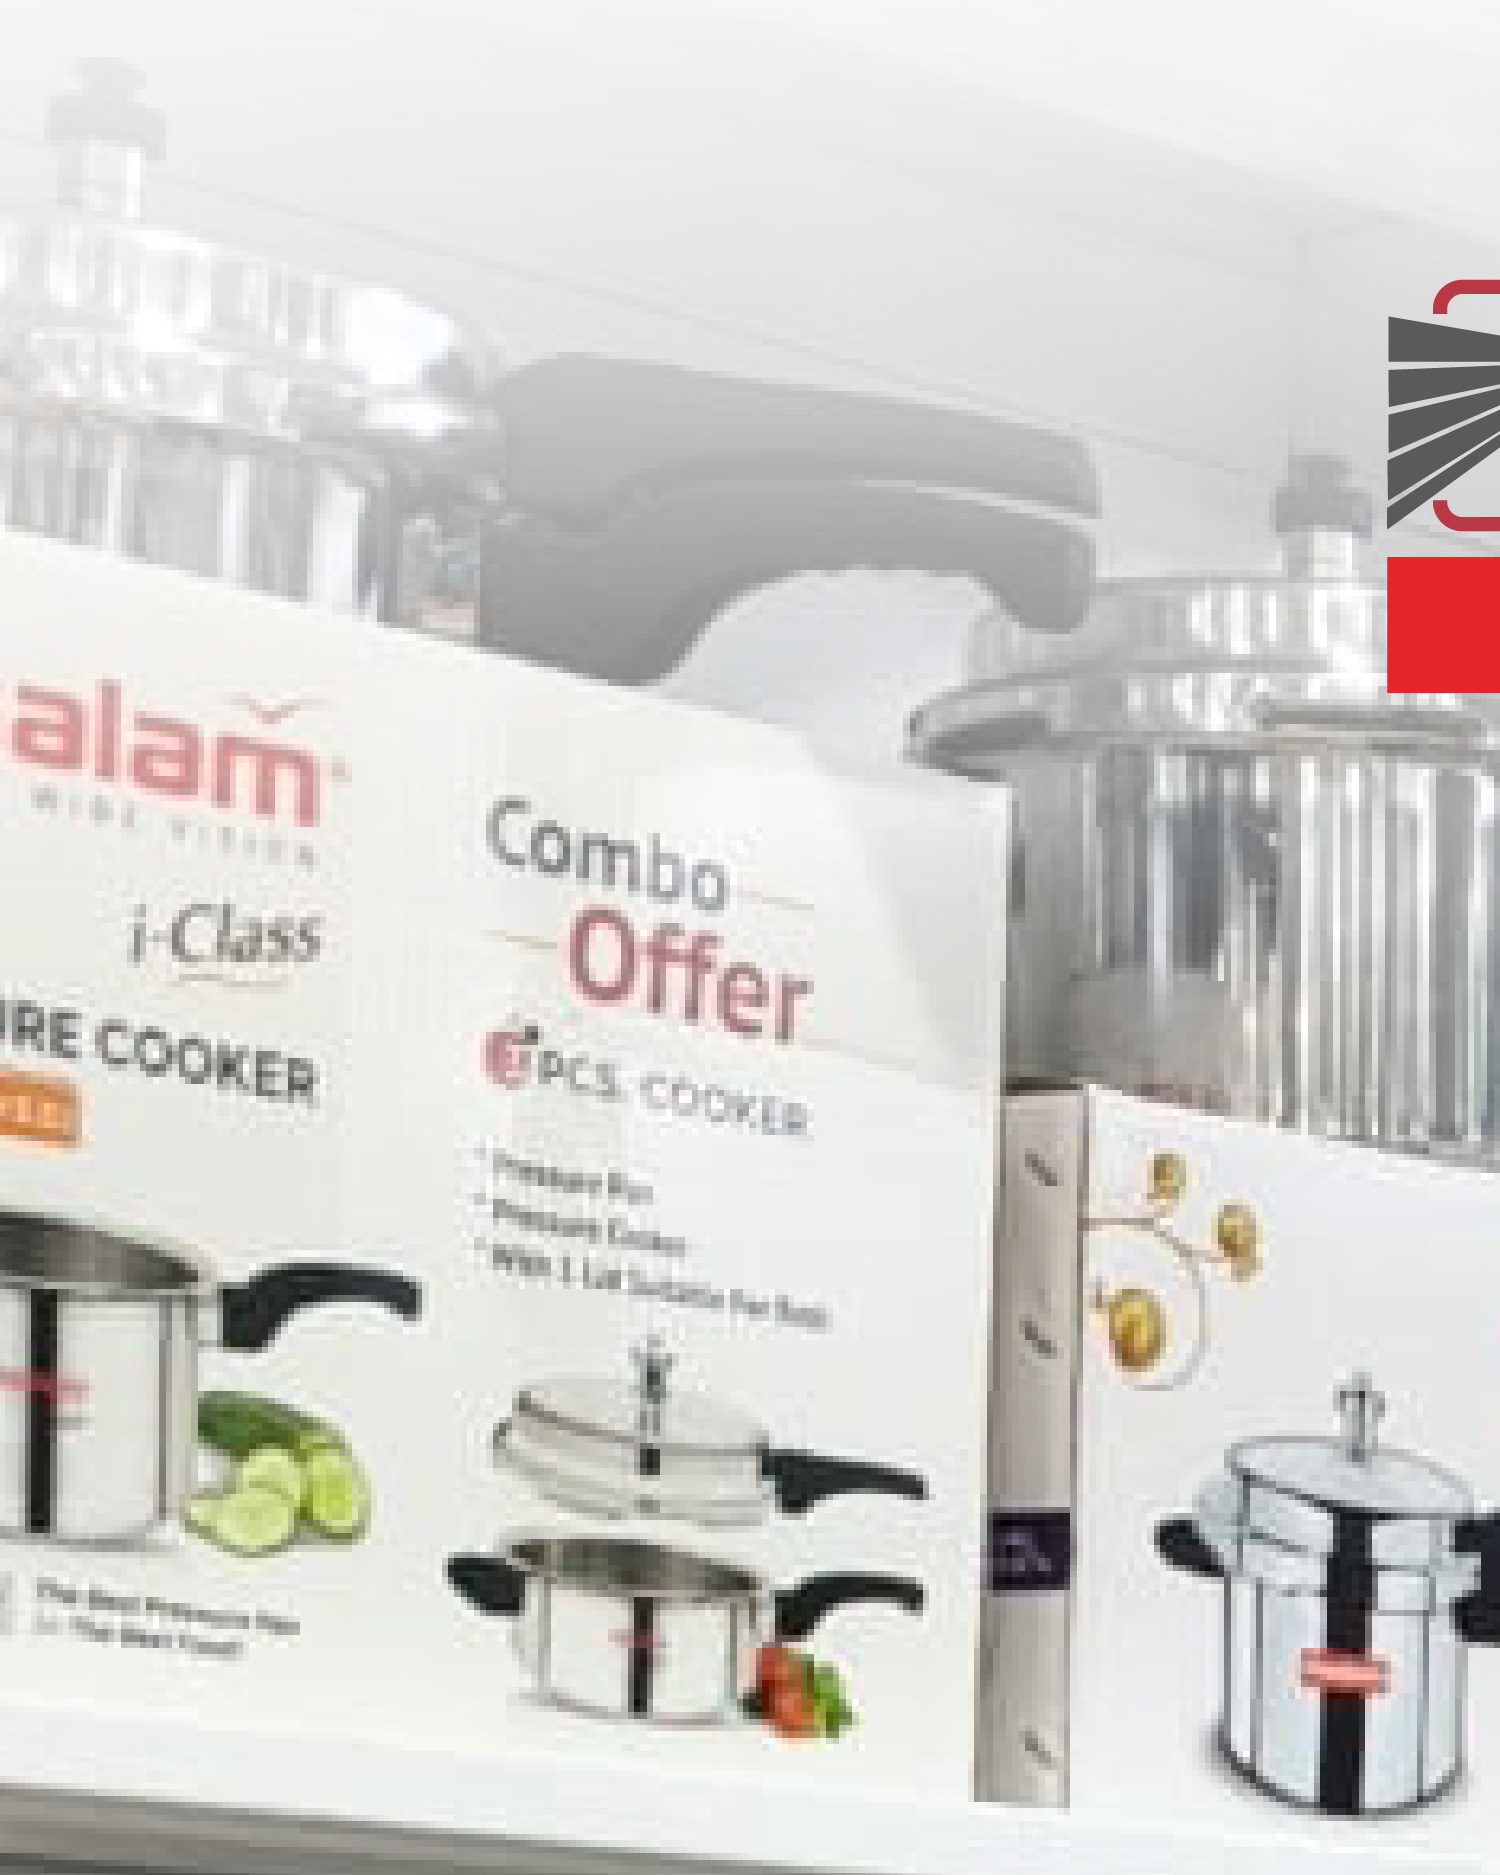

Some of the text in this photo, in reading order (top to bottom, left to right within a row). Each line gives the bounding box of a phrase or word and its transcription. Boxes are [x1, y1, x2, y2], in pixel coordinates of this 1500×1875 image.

[10, 678, 320, 828] alam
[486, 796, 730, 915] Combo
[568, 906, 814, 1045] Offer
[95, 1018, 320, 1108] COOKER
[640, 1075, 808, 1140] COOKER
